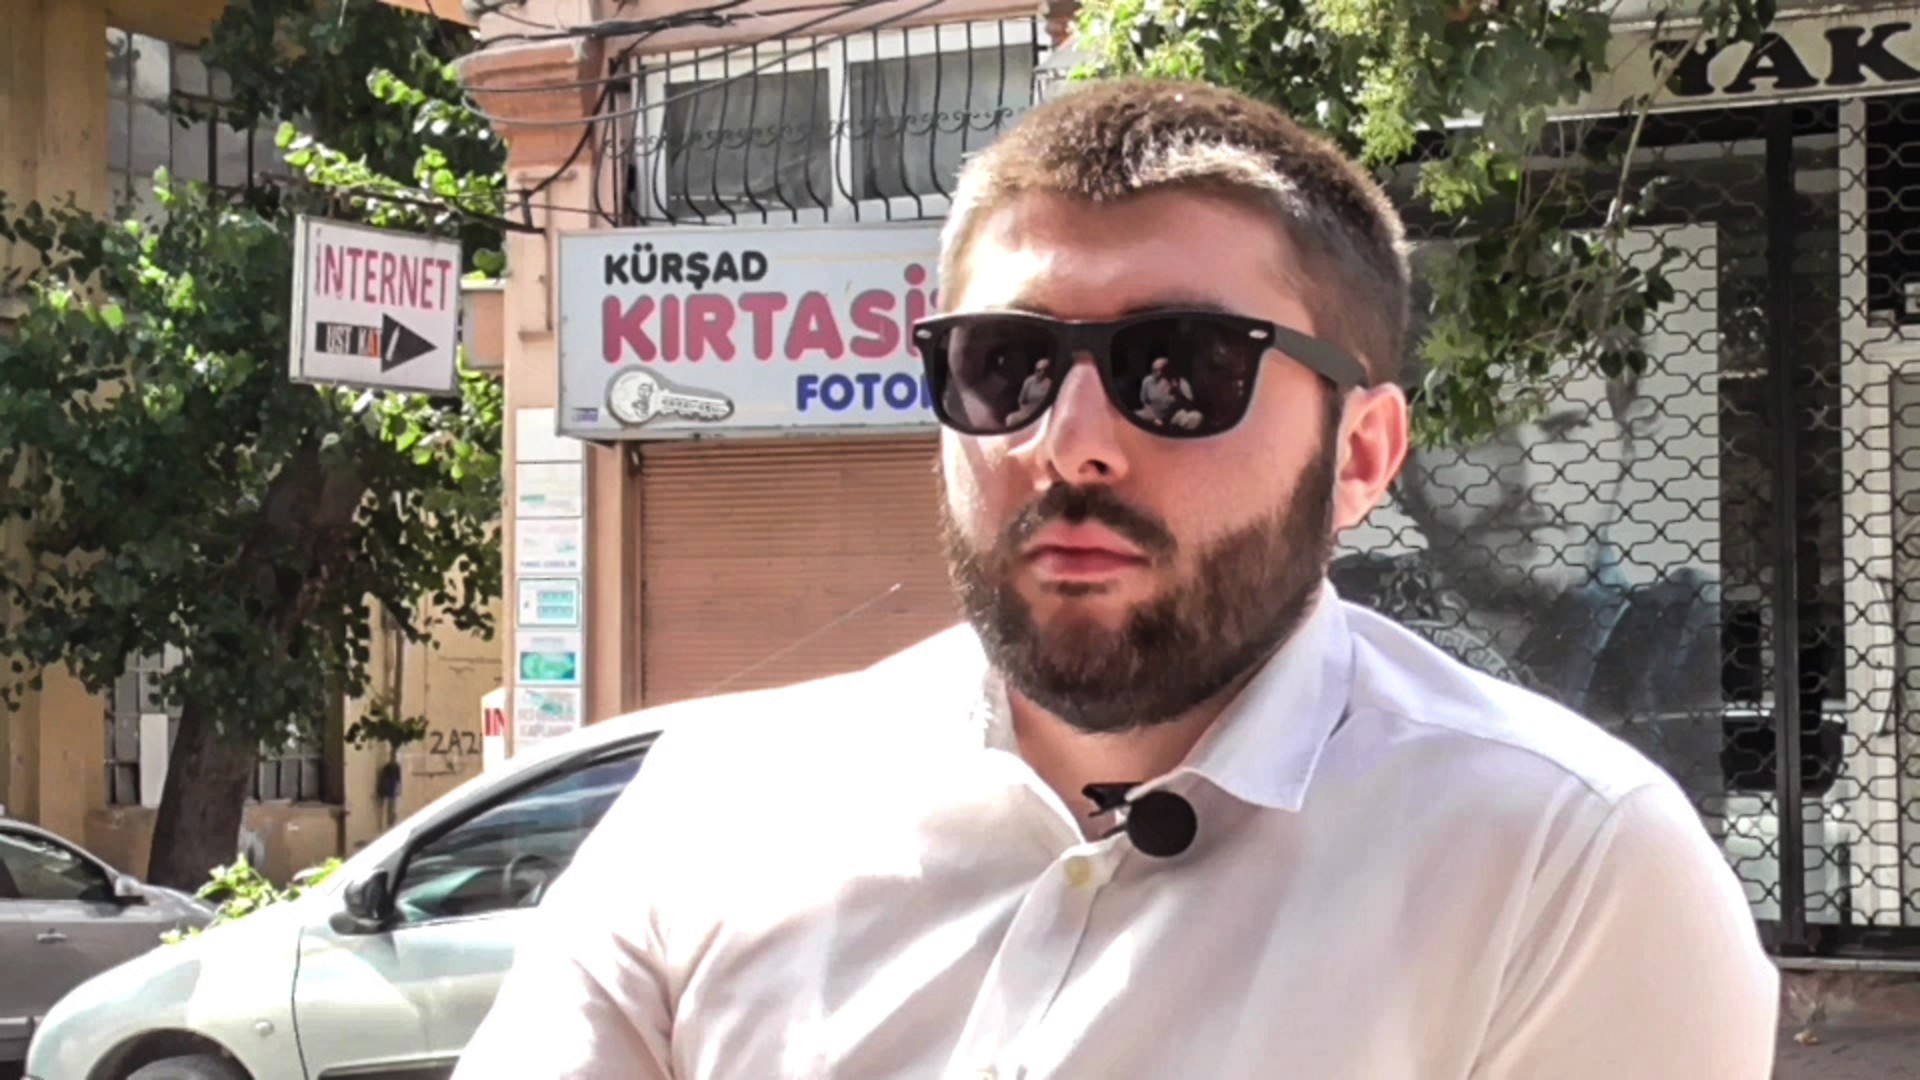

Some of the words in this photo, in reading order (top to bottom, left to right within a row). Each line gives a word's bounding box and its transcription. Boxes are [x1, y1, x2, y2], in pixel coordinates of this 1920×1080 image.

[604, 243, 768, 290] KÜRŞAD
[601, 263, 940, 363] KIRTASİ
[796, 371, 932, 412] FOTO
